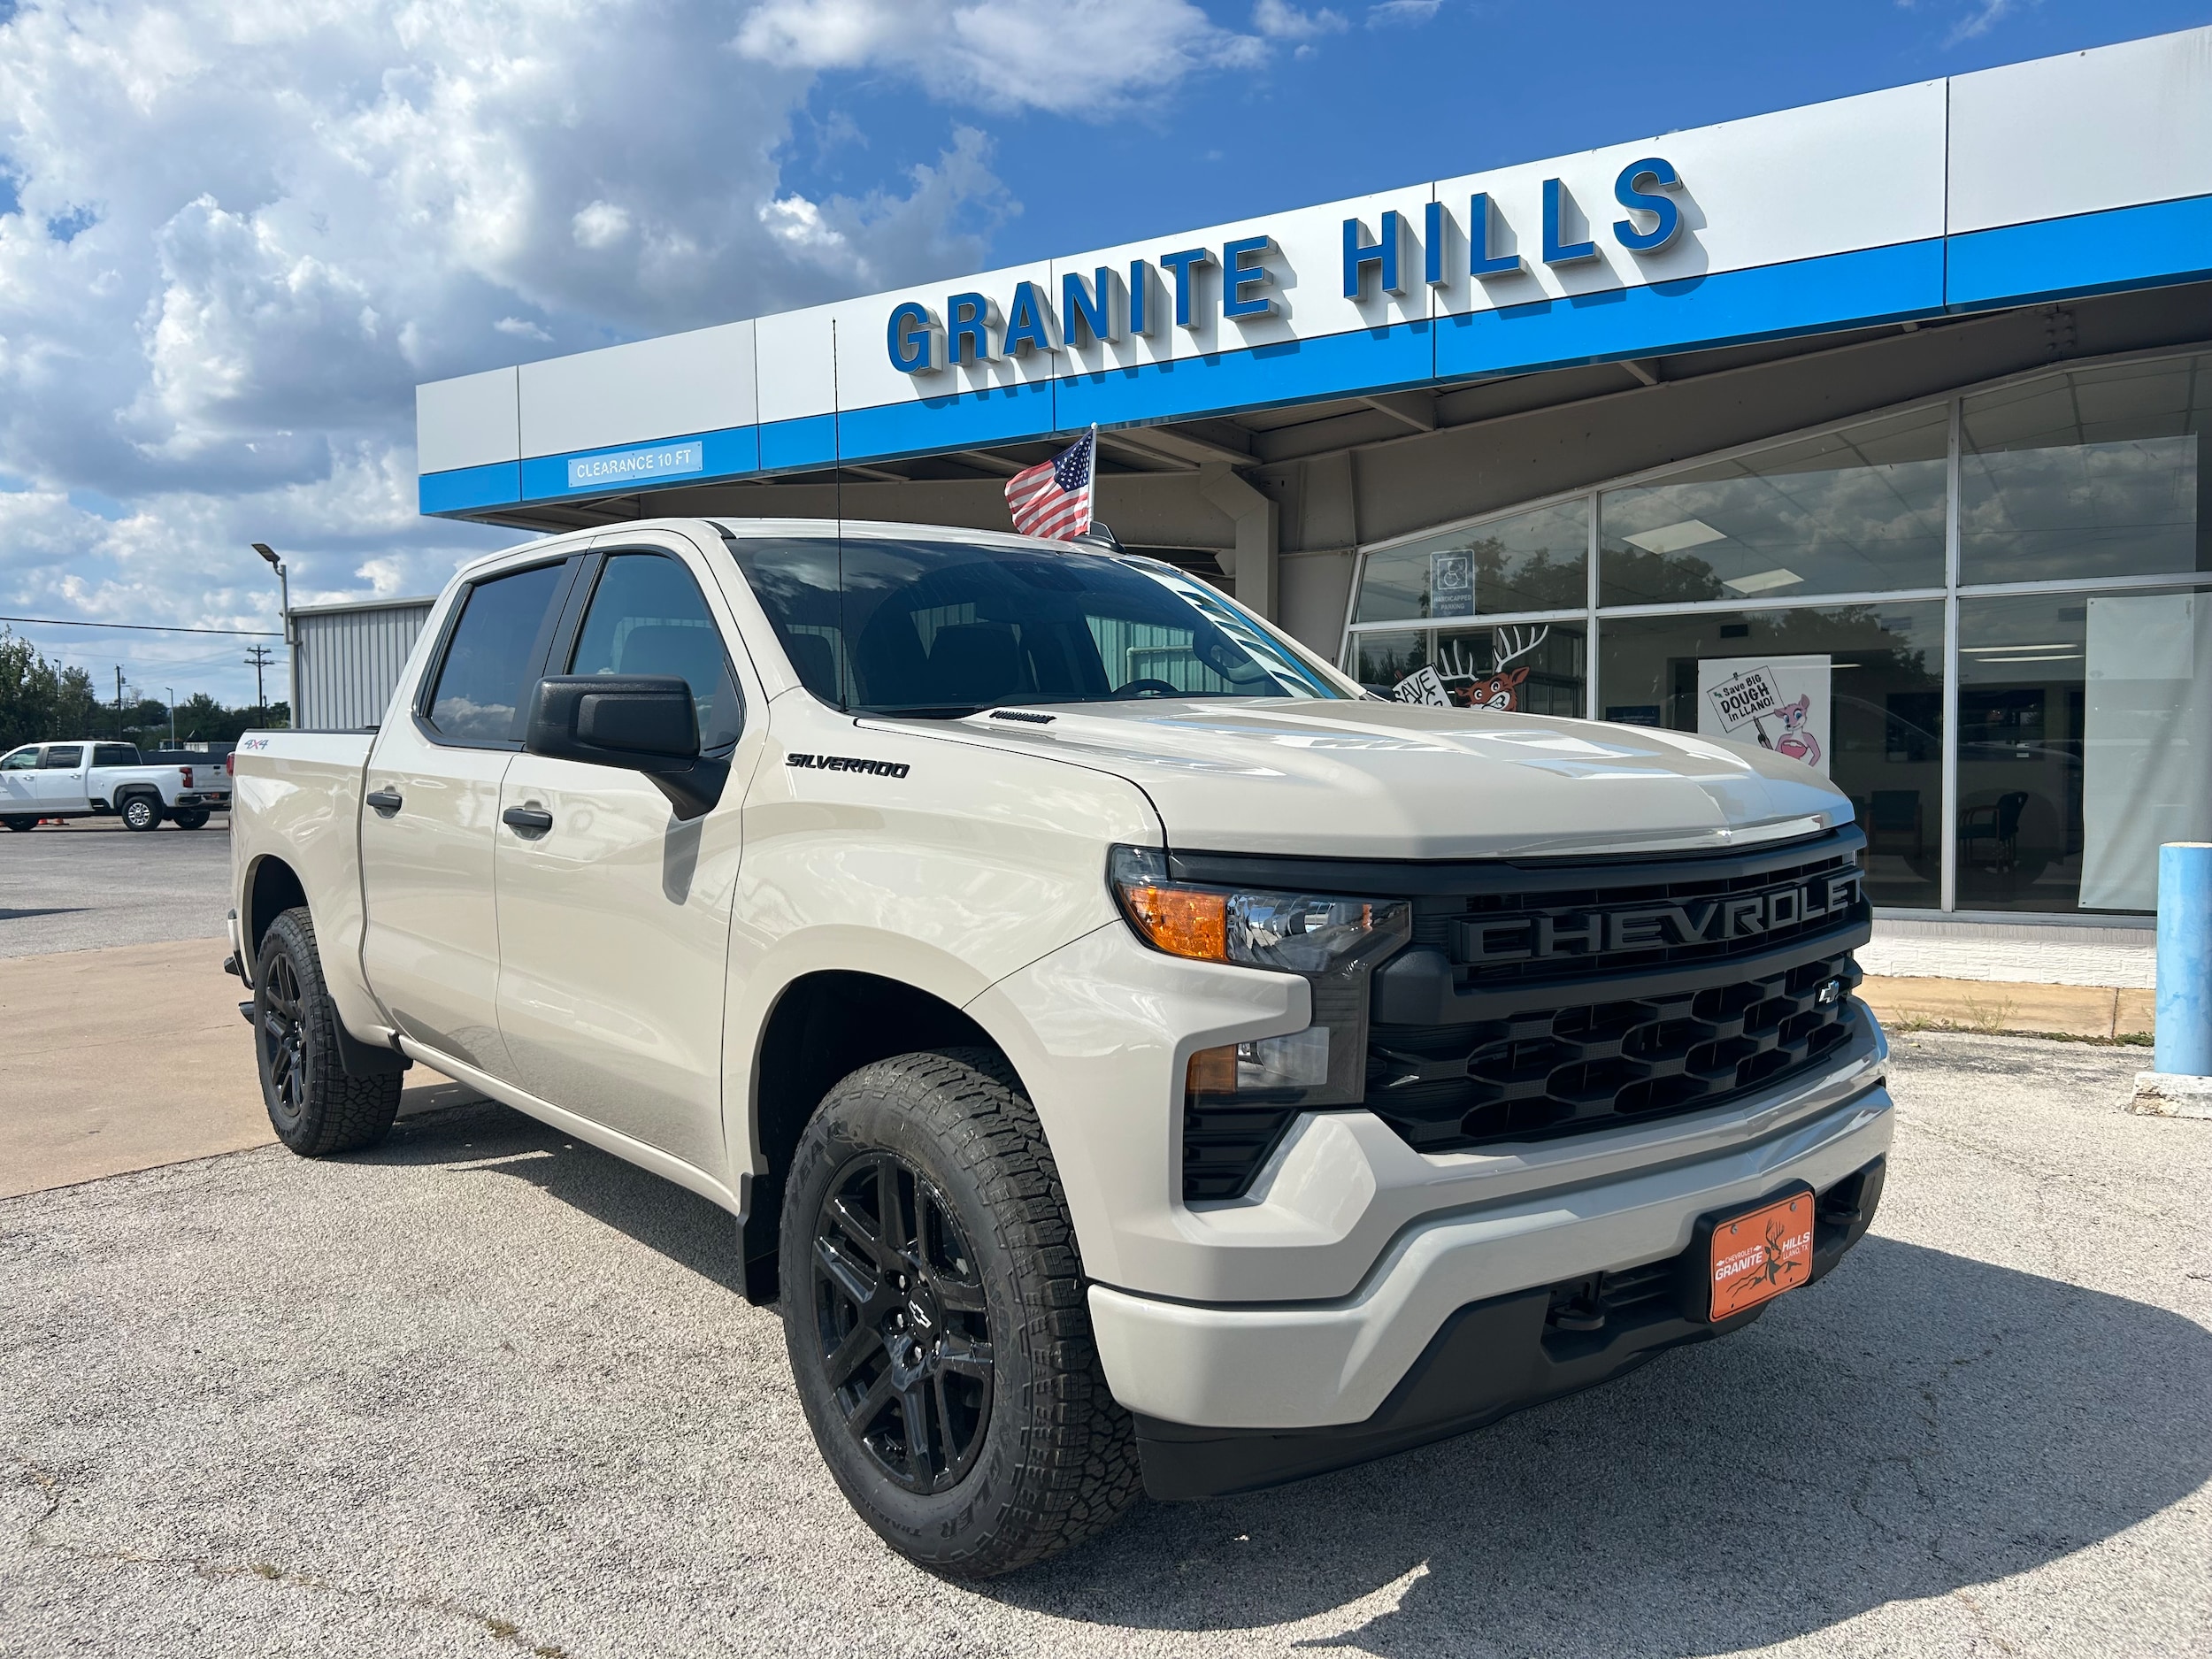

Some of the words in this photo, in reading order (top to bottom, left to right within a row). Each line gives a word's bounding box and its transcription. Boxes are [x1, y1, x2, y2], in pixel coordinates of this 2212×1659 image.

[887, 235, 1279, 376] GRANITE
[1342, 157, 1683, 301] HILLS
[577, 455, 653, 478] CLEARANCE
[658, 453, 672, 467] 10
[675, 449, 691, 465] FT
[1434, 594, 1472, 603] HANDICAPPED
[1394, 670, 1436, 703] SAVE
[1720, 682, 1770, 714] DOUGH
[1723, 683, 1745, 696] Save
[1745, 674, 1762, 687] BIG
[1739, 695, 1775, 718] LLANO!
[786, 753, 910, 779] SILVERADO
[1455, 872, 1864, 963] CHEVROLET
[1715, 1251, 1763, 1281] GRANITE
[1782, 1231, 1810, 1252] HILLS
[1725, 1247, 1754, 1264] CHEVROLET
